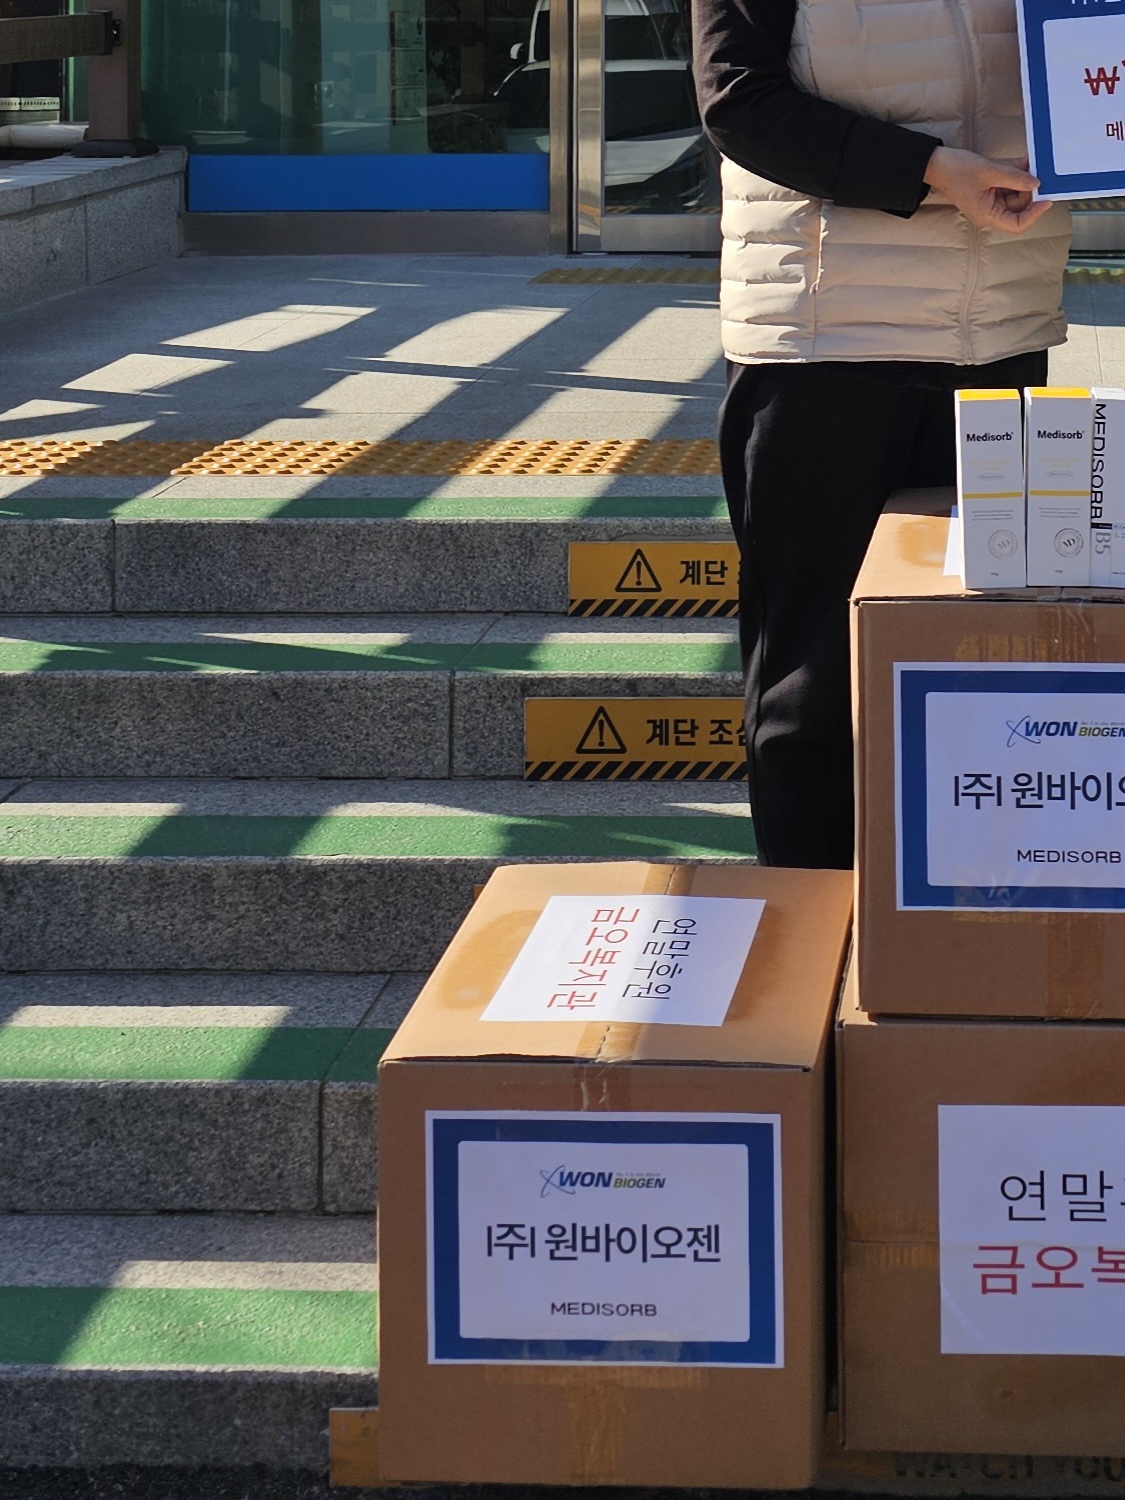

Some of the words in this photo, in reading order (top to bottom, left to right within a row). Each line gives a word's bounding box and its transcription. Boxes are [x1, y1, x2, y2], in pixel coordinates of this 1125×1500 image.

[1090, 403, 1107, 521] MEDISORB
[1095, 532, 1111, 554] B5
[680, 560, 728, 586] 계단
[646, 719, 699, 746] 계단
[1025, 721, 1078, 737] WON
[1017, 849, 1121, 863] MEDISORB
[547, 906, 640, 1011] 금오복지관
[623, 918, 697, 1000] 연말후원
[559, 1171, 613, 1188] WON
[613, 1178, 666, 1188] BIOGEN
[551, 1302, 657, 1317] MEDISORB
